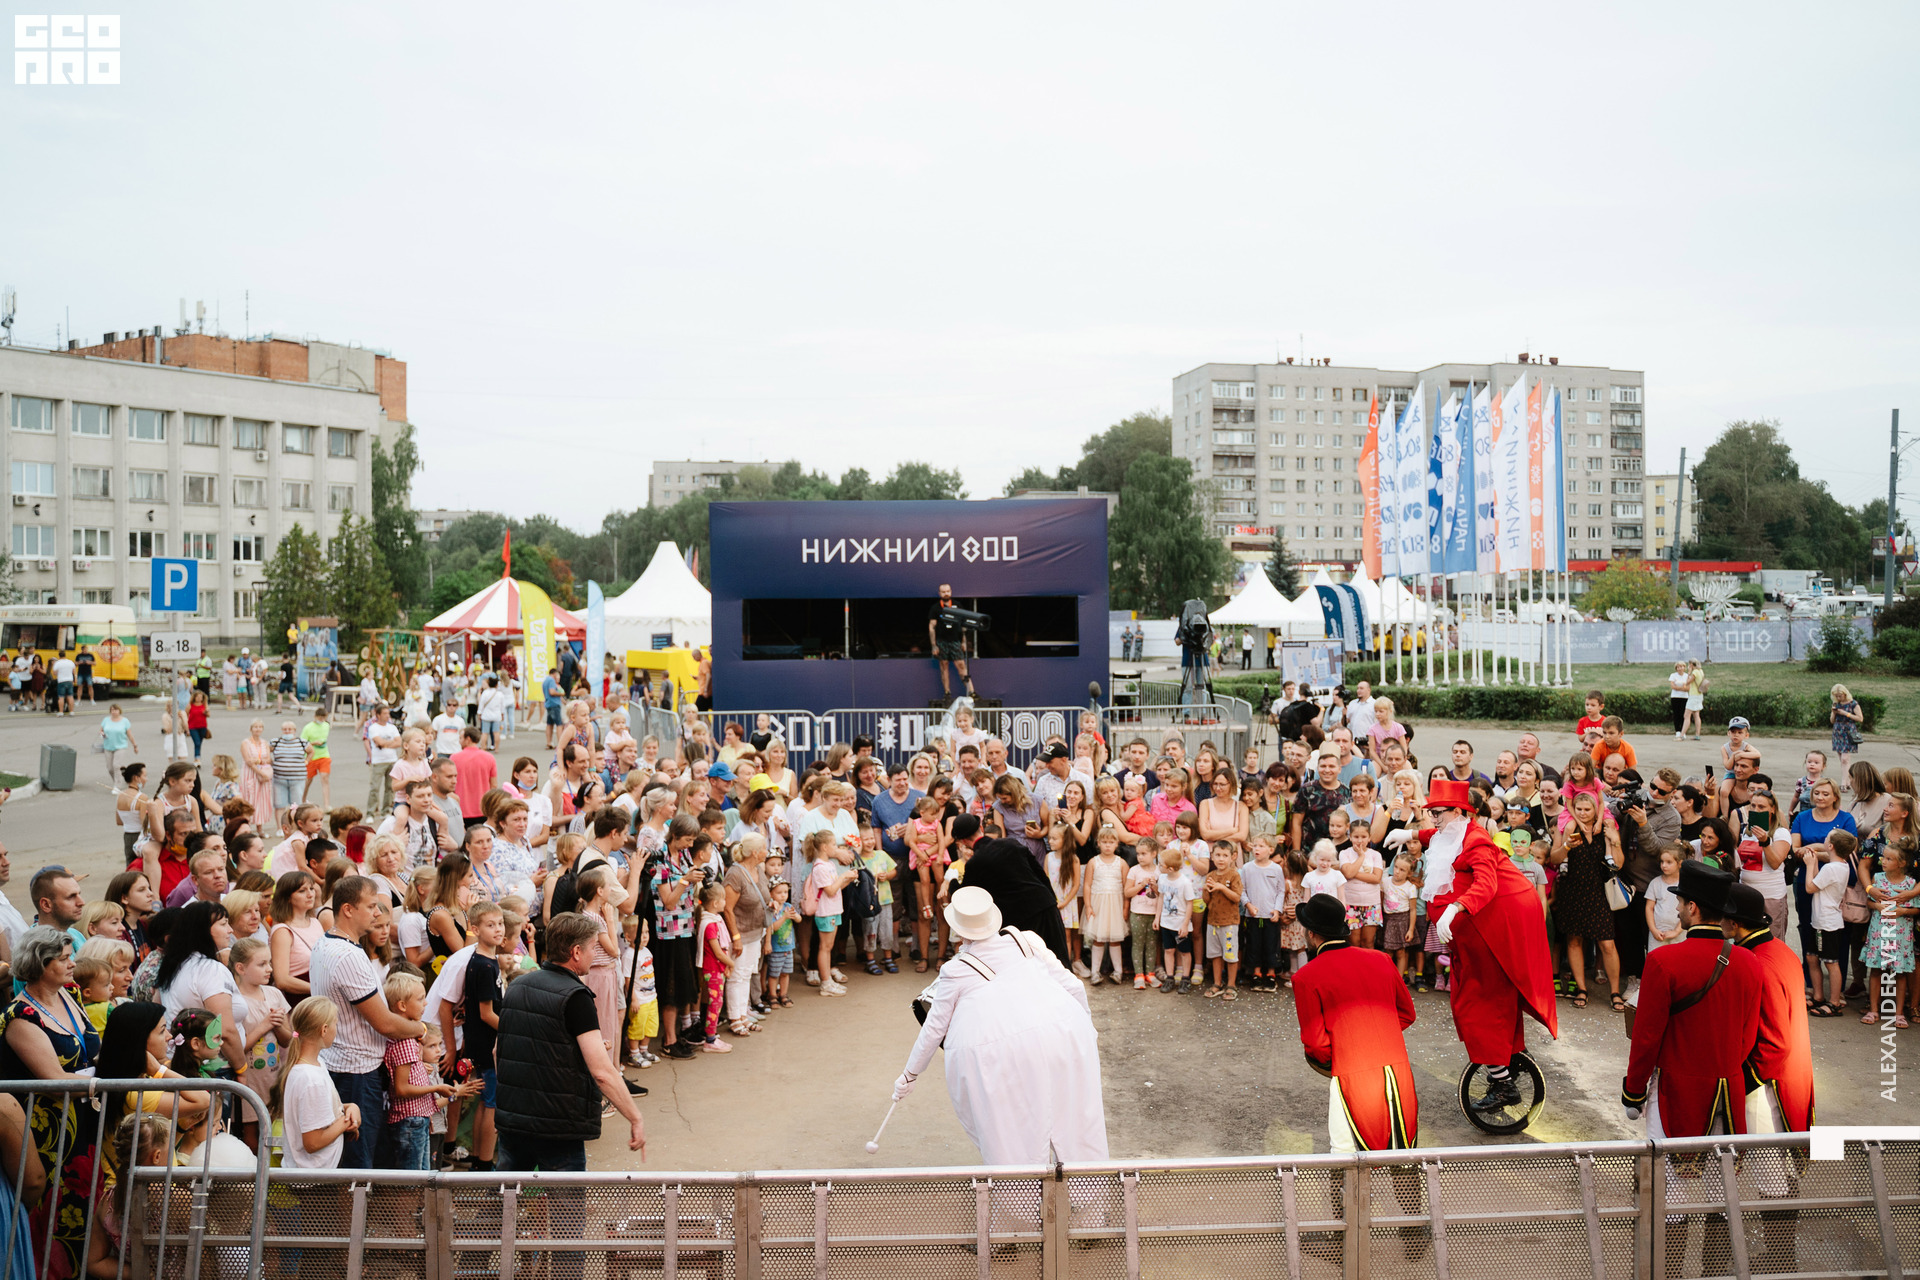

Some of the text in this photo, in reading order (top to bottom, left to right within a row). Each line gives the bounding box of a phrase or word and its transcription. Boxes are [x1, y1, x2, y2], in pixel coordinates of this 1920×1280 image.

[802, 532, 1018, 563] НИЖНИЙ 800
[164, 563, 188, 607] P
